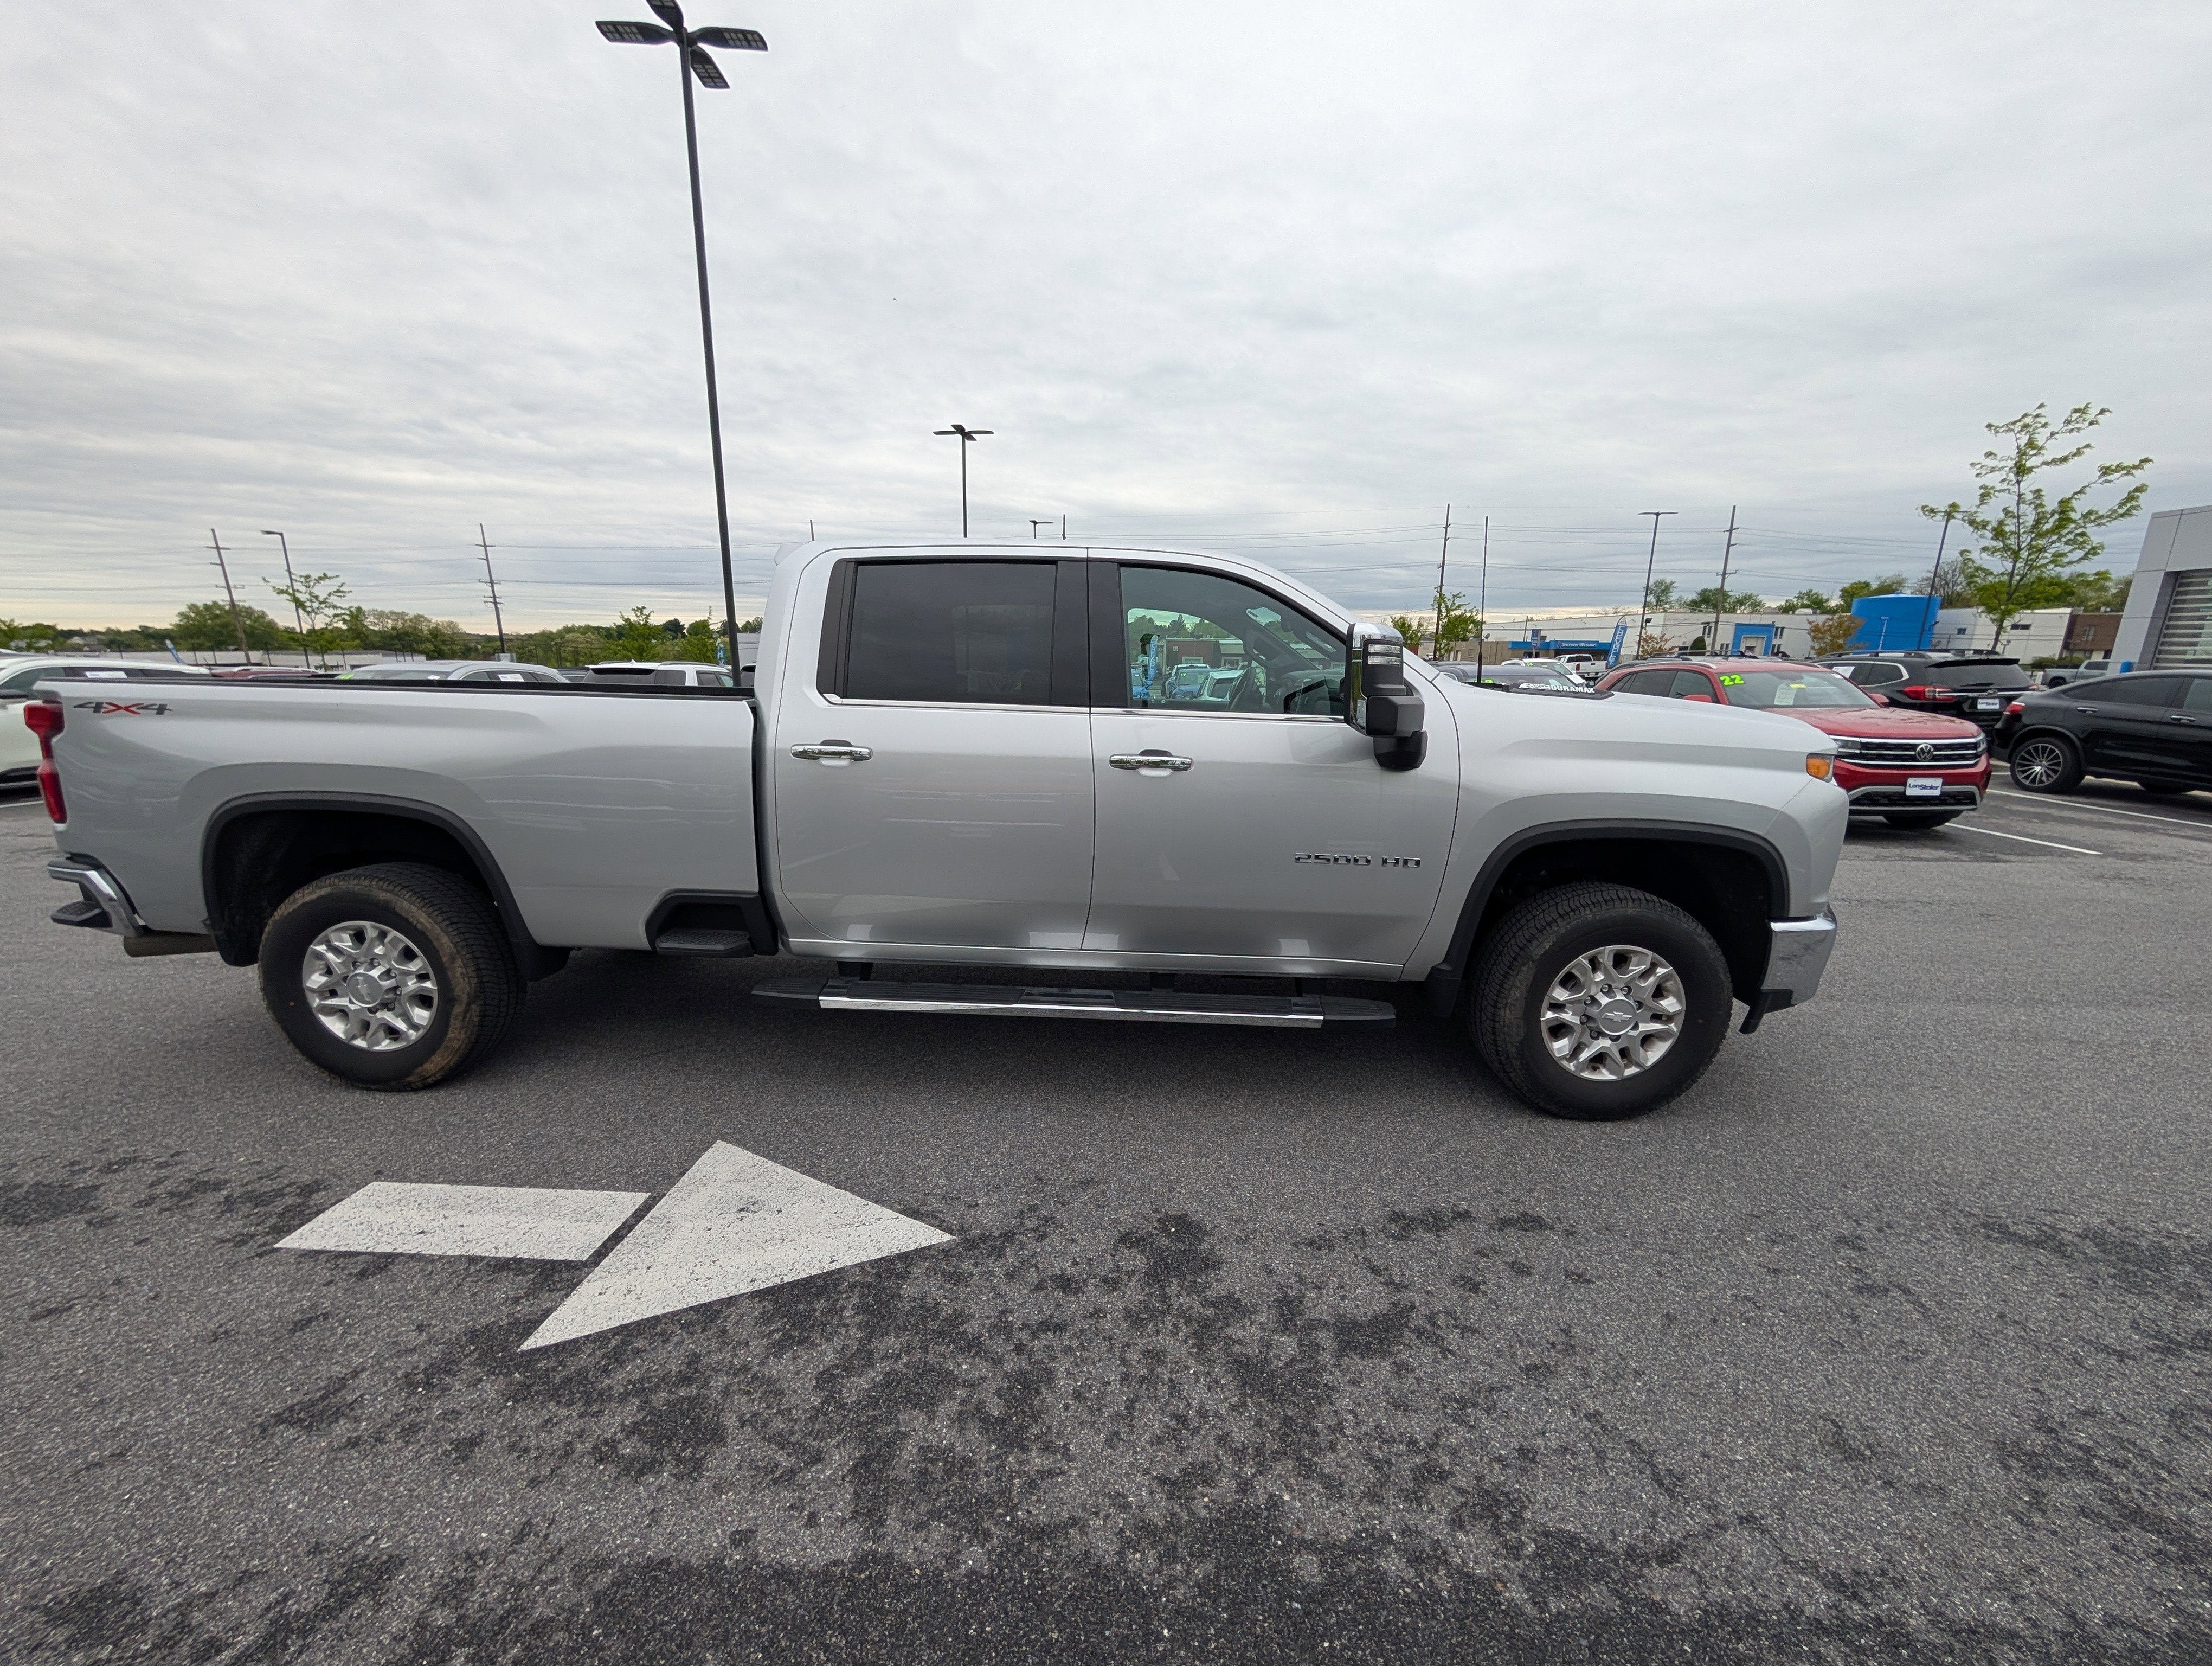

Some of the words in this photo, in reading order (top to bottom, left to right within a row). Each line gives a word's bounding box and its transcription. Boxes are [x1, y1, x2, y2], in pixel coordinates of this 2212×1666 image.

[1720, 675, 1745, 685] 22
[1551, 685, 1595, 694] DURAMAX
[1295, 853, 1371, 865] 2500
[1382, 856, 1421, 868] HD
